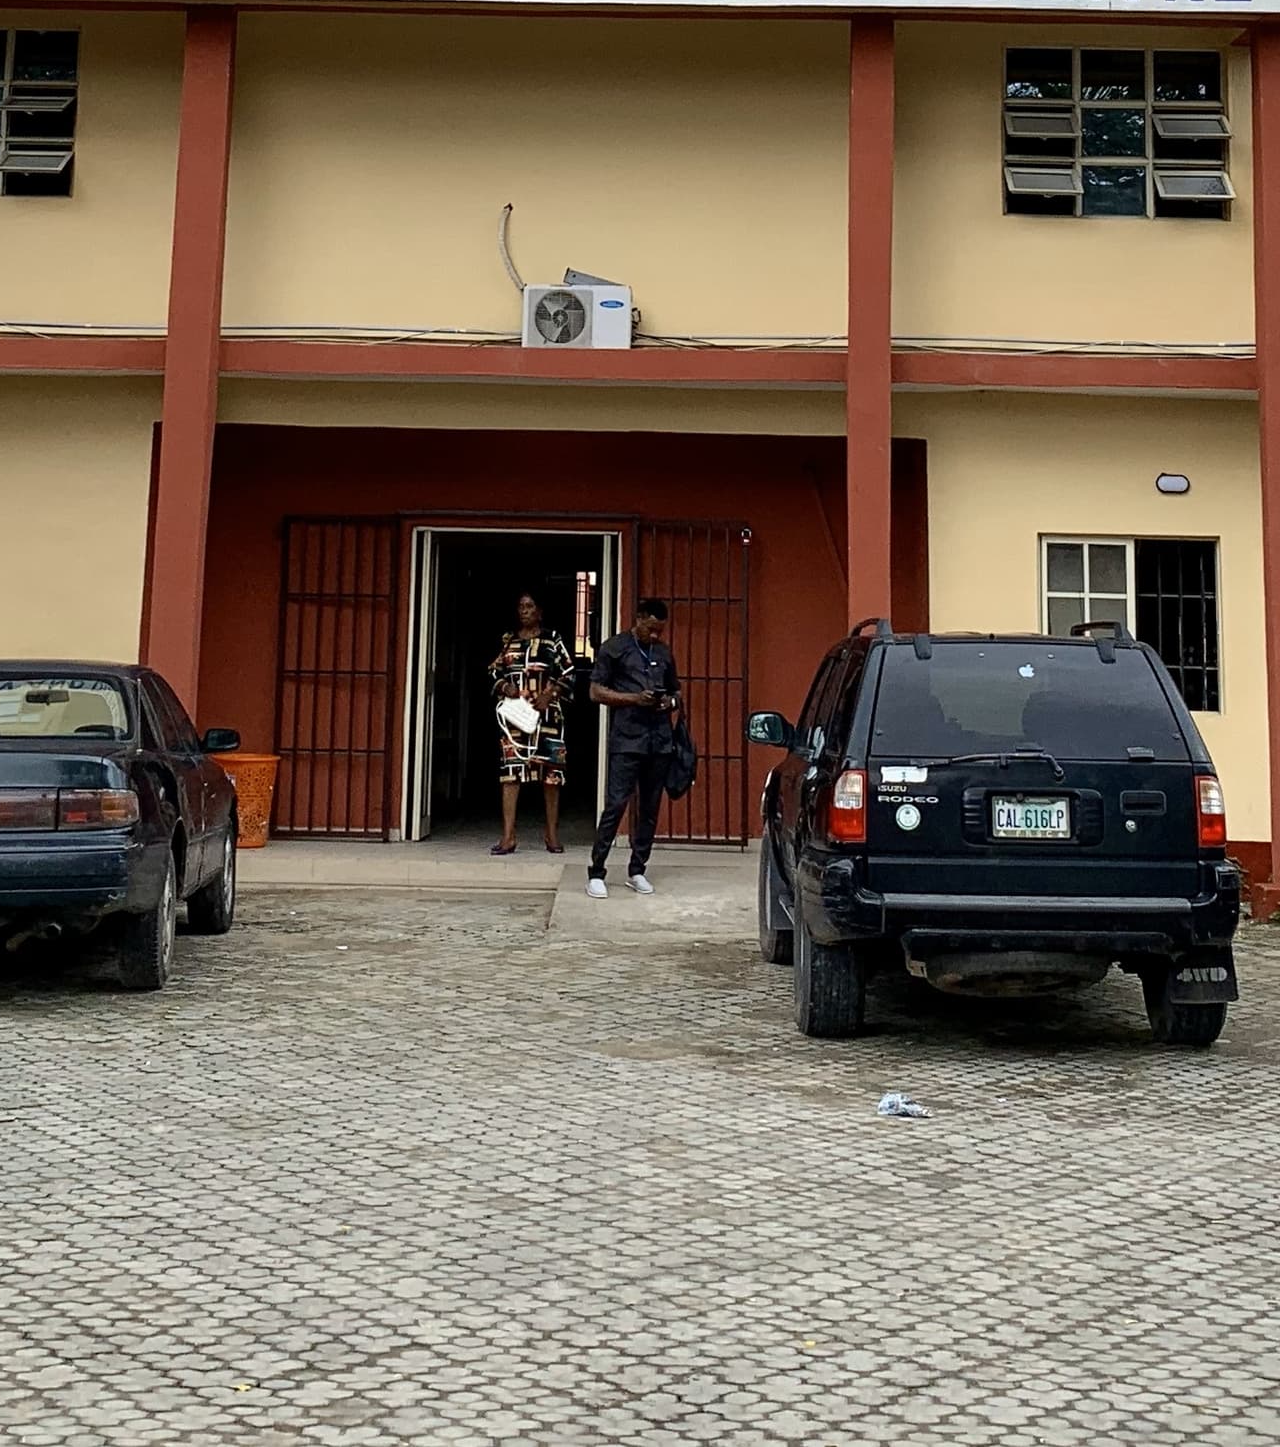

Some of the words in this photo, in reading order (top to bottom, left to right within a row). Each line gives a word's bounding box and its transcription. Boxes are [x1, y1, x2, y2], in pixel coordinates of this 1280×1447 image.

[877, 785, 907, 793] ISUZU
[877, 795, 939, 804] RODEO
[997, 808, 1064, 829] CAL-616LP
